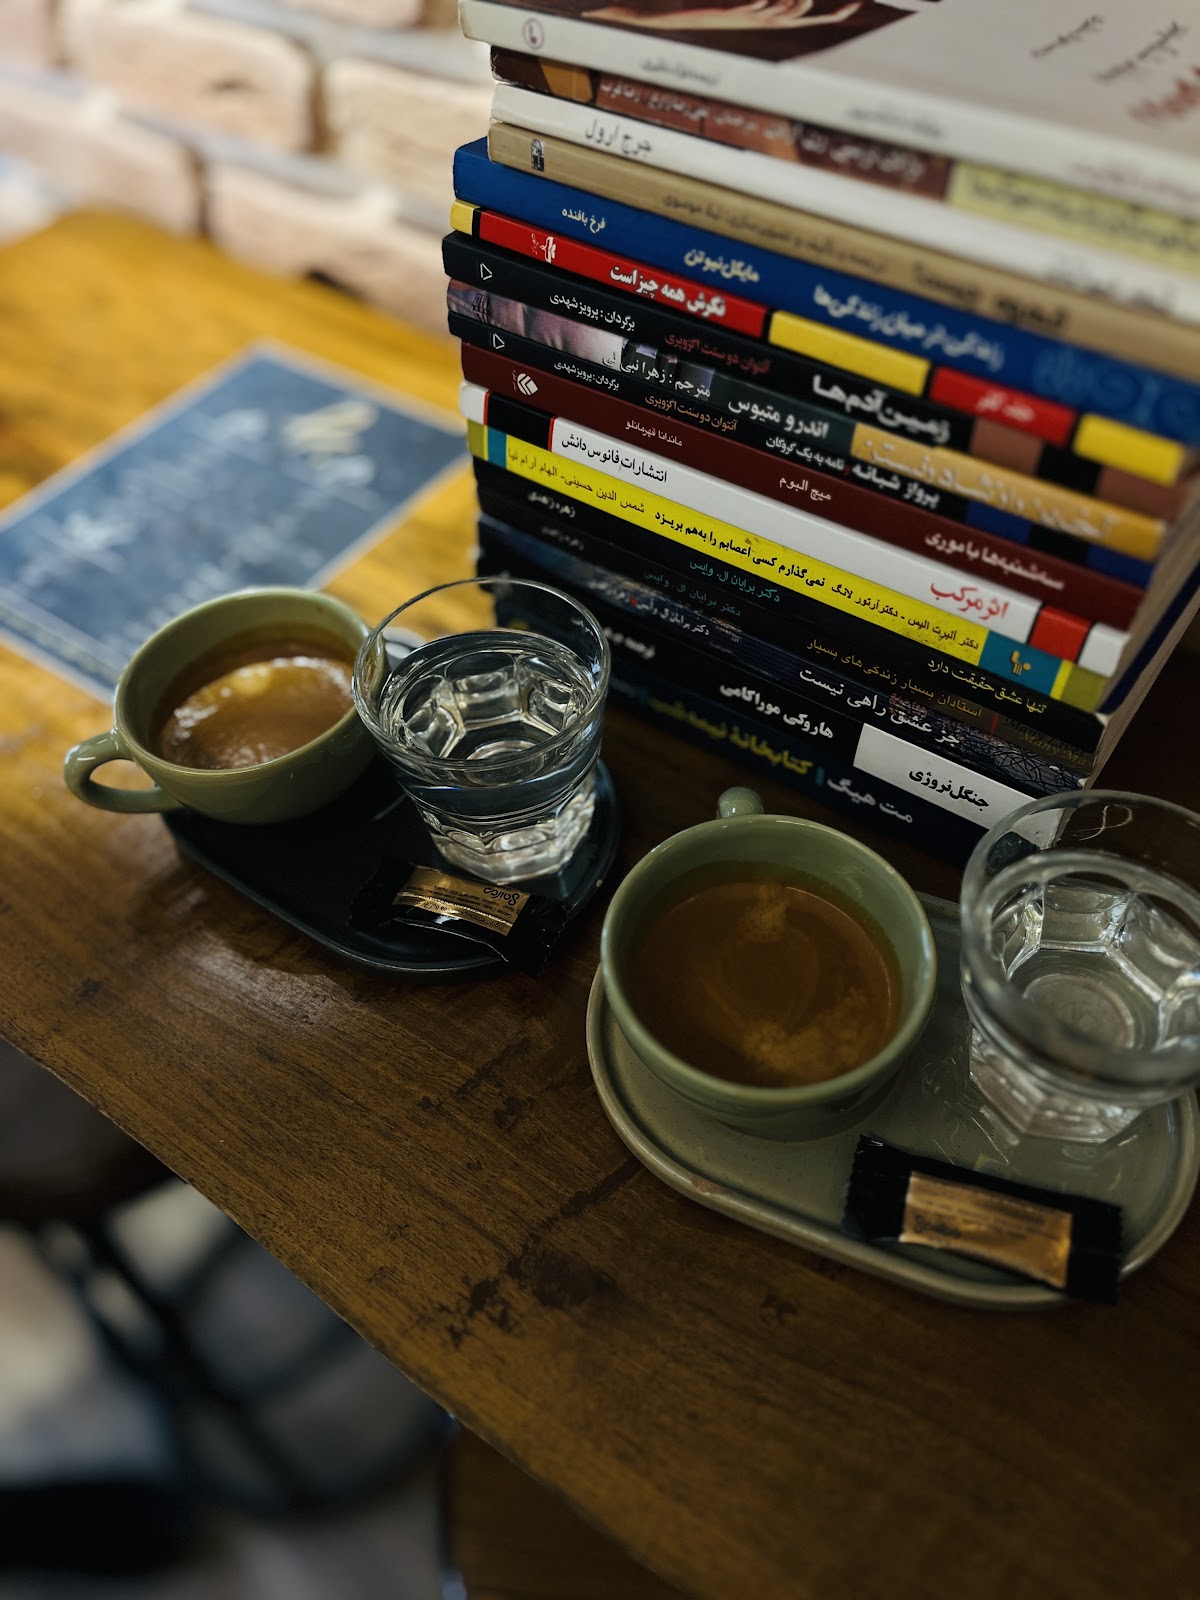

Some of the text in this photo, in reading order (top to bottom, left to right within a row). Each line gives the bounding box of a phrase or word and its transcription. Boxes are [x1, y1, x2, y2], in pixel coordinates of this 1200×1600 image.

[585, 119, 652, 157] جرج ارول
[561, 207, 606, 234] فرخ بافنده
[684, 249, 723, 272] نیوتن
[609, 265, 727, 318] نگرش همه چیز است
[549, 293, 579, 310] شهدی
[578, 301, 600, 321] پرویز
[701, 344, 726, 361] سنت
[553, 361, 576, 376] شهدی
[576, 368, 593, 386] پرویز
[642, 360, 667, 384] زهرا
[677, 404, 700, 419] سنت
[700, 413, 711, 424] دو
[728, 401, 829, 439] اندرو متیوس
[624, 418, 683, 447] ماندانا قهرمانلو
[711, 417, 737, 432] آنتوان
[878, 408, 950, 445] زمین
[561, 433, 668, 483] انتشارات فانوس دانش
[796, 447, 813, 463] یک
[814, 453, 825, 466] به
[825, 457, 845, 471] نامه
[539, 463, 558, 478] الهام
[851, 464, 901, 491] شبانه
[596, 488, 617, 502] الدین
[810, 486, 832, 501] میچ
[903, 480, 940, 510] پرواز
[619, 499, 646, 514] شمس
[709, 532, 718, 547] را
[718, 539, 752, 558] اعصابم
[925, 532, 965, 555] موری
[965, 541, 981, 561] با
[689, 559, 714, 577] وایس
[752, 556, 778, 568] کسی
[643, 570, 670, 588] وایس
[730, 574, 756, 594] برایان
[758, 589, 780, 603] دکتر
[831, 585, 854, 600] لانگ
[719, 604, 741, 617] دکتر
[854, 595, 880, 611] آرتور
[929, 582, 1010, 622] اثر مرکب
[878, 605, 898, 618] دکتر
[691, 624, 710, 636] دکتر
[908, 618, 930, 631] الیس
[932, 626, 958, 642] آلبرت
[806, 638, 838, 661] بسیار
[958, 637, 979, 650] دکتر
[900, 677, 935, 699] بسیار
[927, 658, 1047, 714] تنها عشق حقیقت دارد
[718, 684, 834, 739] هاروکی موراکامی
[798, 669, 960, 745] جز عشق راهی نیست
[936, 693, 981, 718] استادان
[908, 767, 989, 812] جنگل نروژی
[826, 776, 913, 824] مت هیگ
